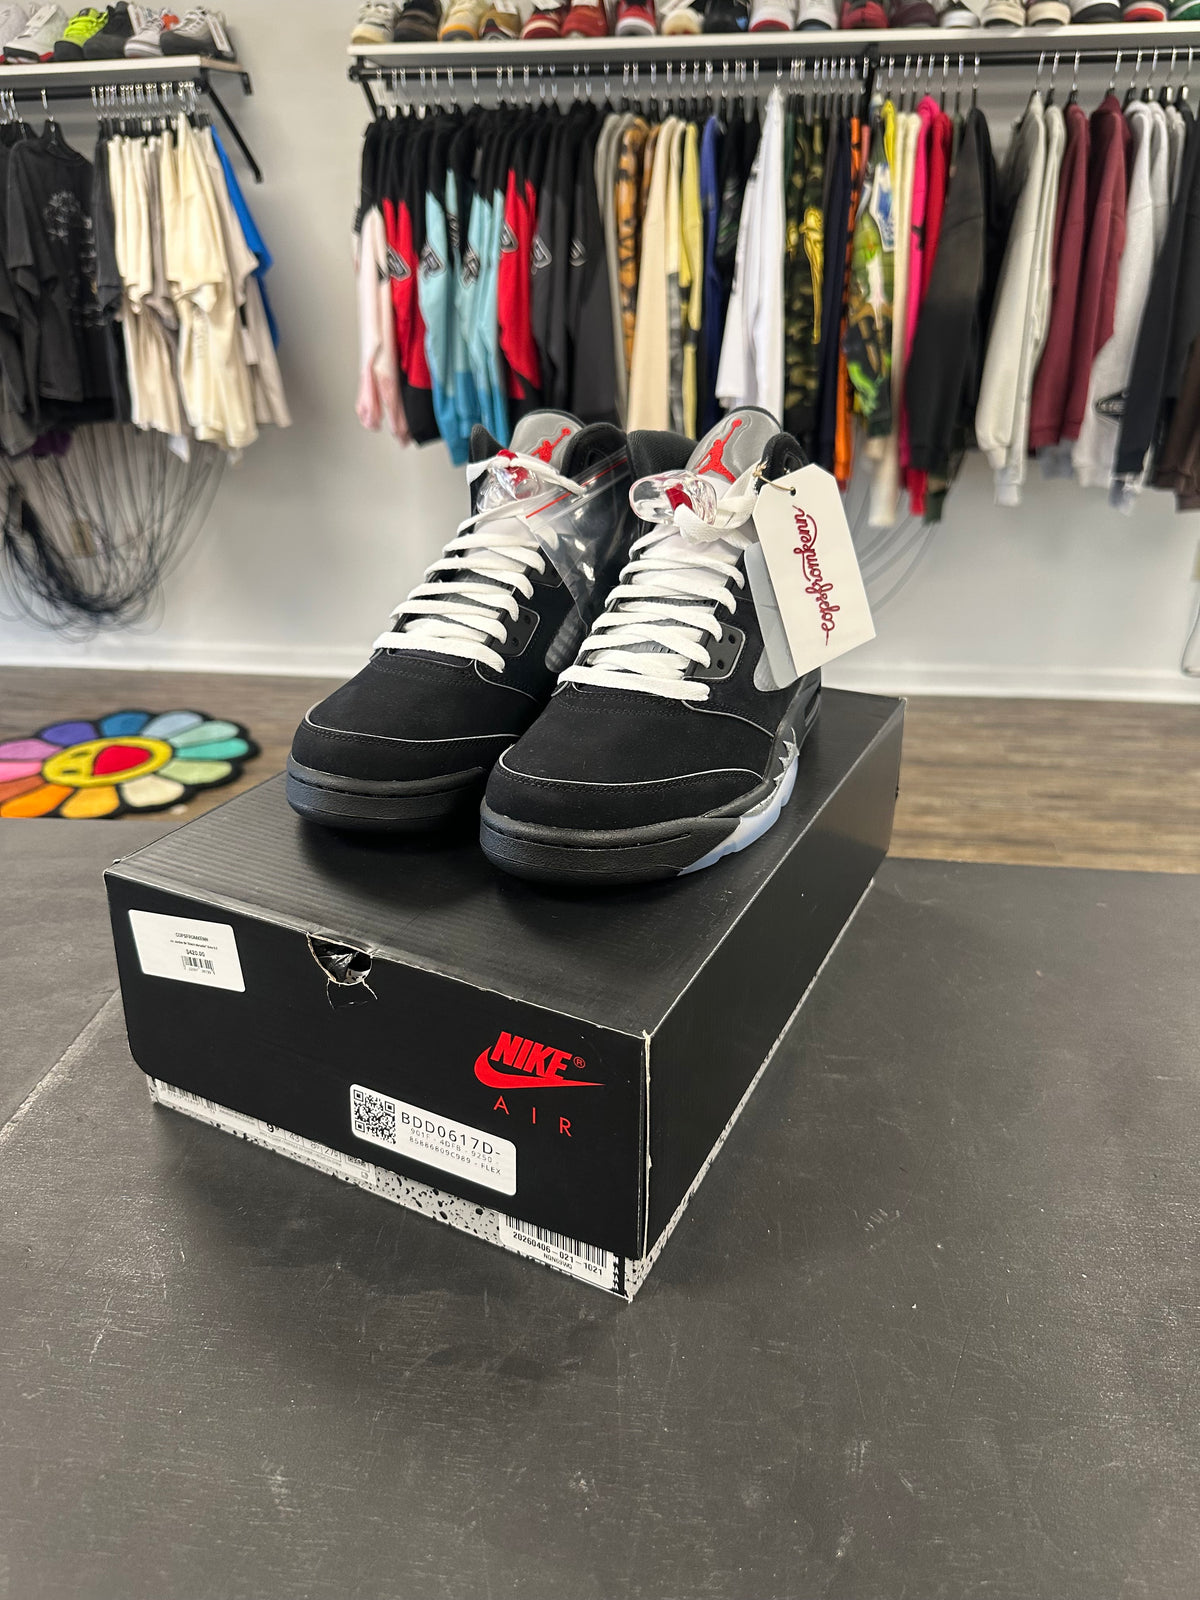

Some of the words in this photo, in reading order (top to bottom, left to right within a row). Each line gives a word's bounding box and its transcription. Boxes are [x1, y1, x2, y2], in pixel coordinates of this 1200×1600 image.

[792, 505, 840, 646] copsfromkenn
[490, 1031, 573, 1080] NIKE
[493, 1095, 573, 1137] AIR
